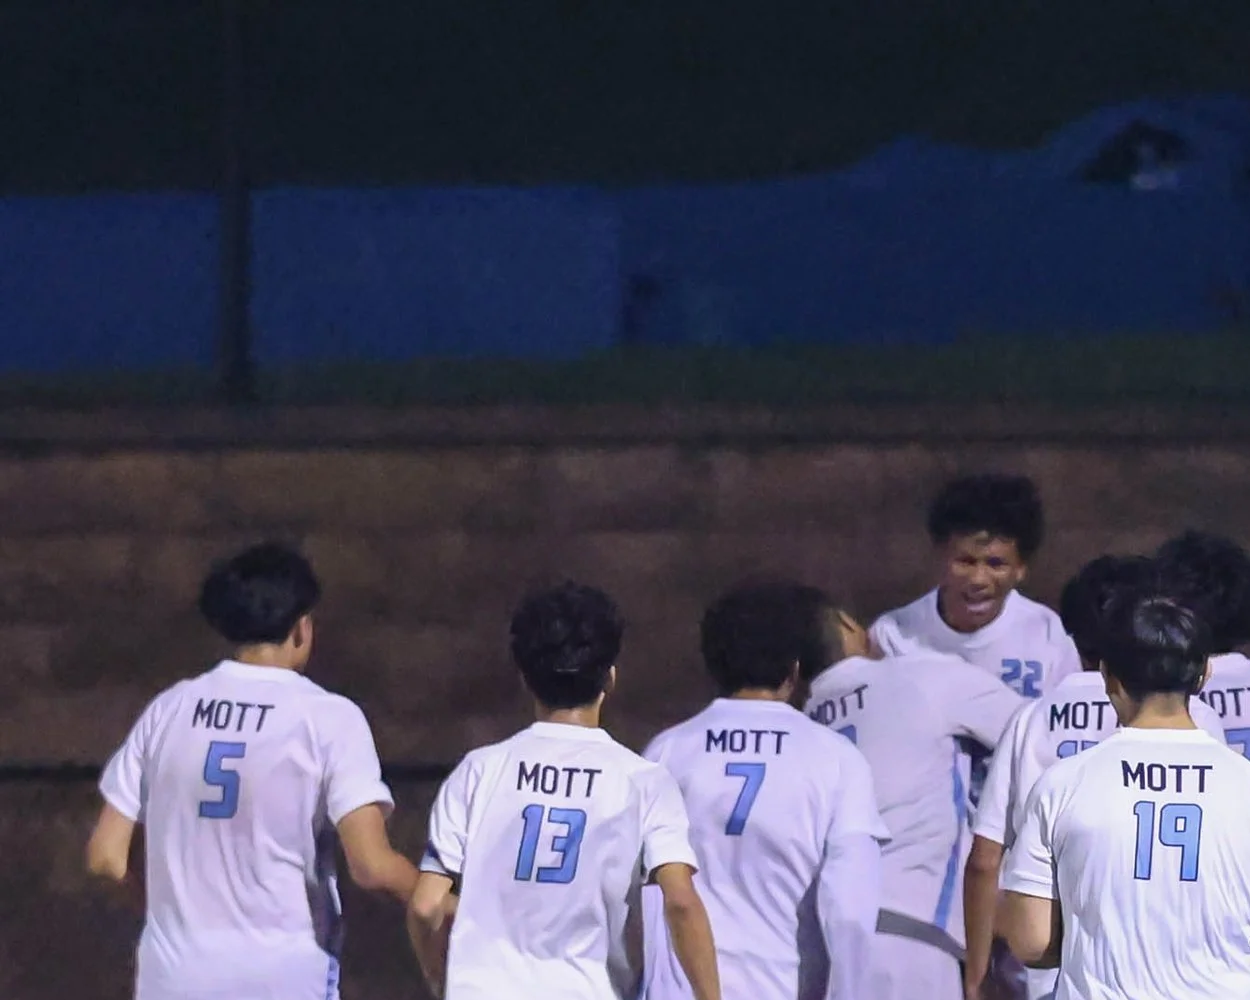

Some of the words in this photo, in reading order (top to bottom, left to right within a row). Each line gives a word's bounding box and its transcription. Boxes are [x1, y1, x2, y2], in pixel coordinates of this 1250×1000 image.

[192, 697, 275, 733] MOTT
[1049, 701, 1121, 732] MOT
[705, 728, 790, 756] MOTT
[198, 740, 247, 820] 5
[516, 760, 602, 798] MOTT
[1120, 759, 1214, 795] MOTT
[723, 761, 767, 836] 7
[513, 803, 587, 885] 13
[1133, 800, 1203, 882] 19
